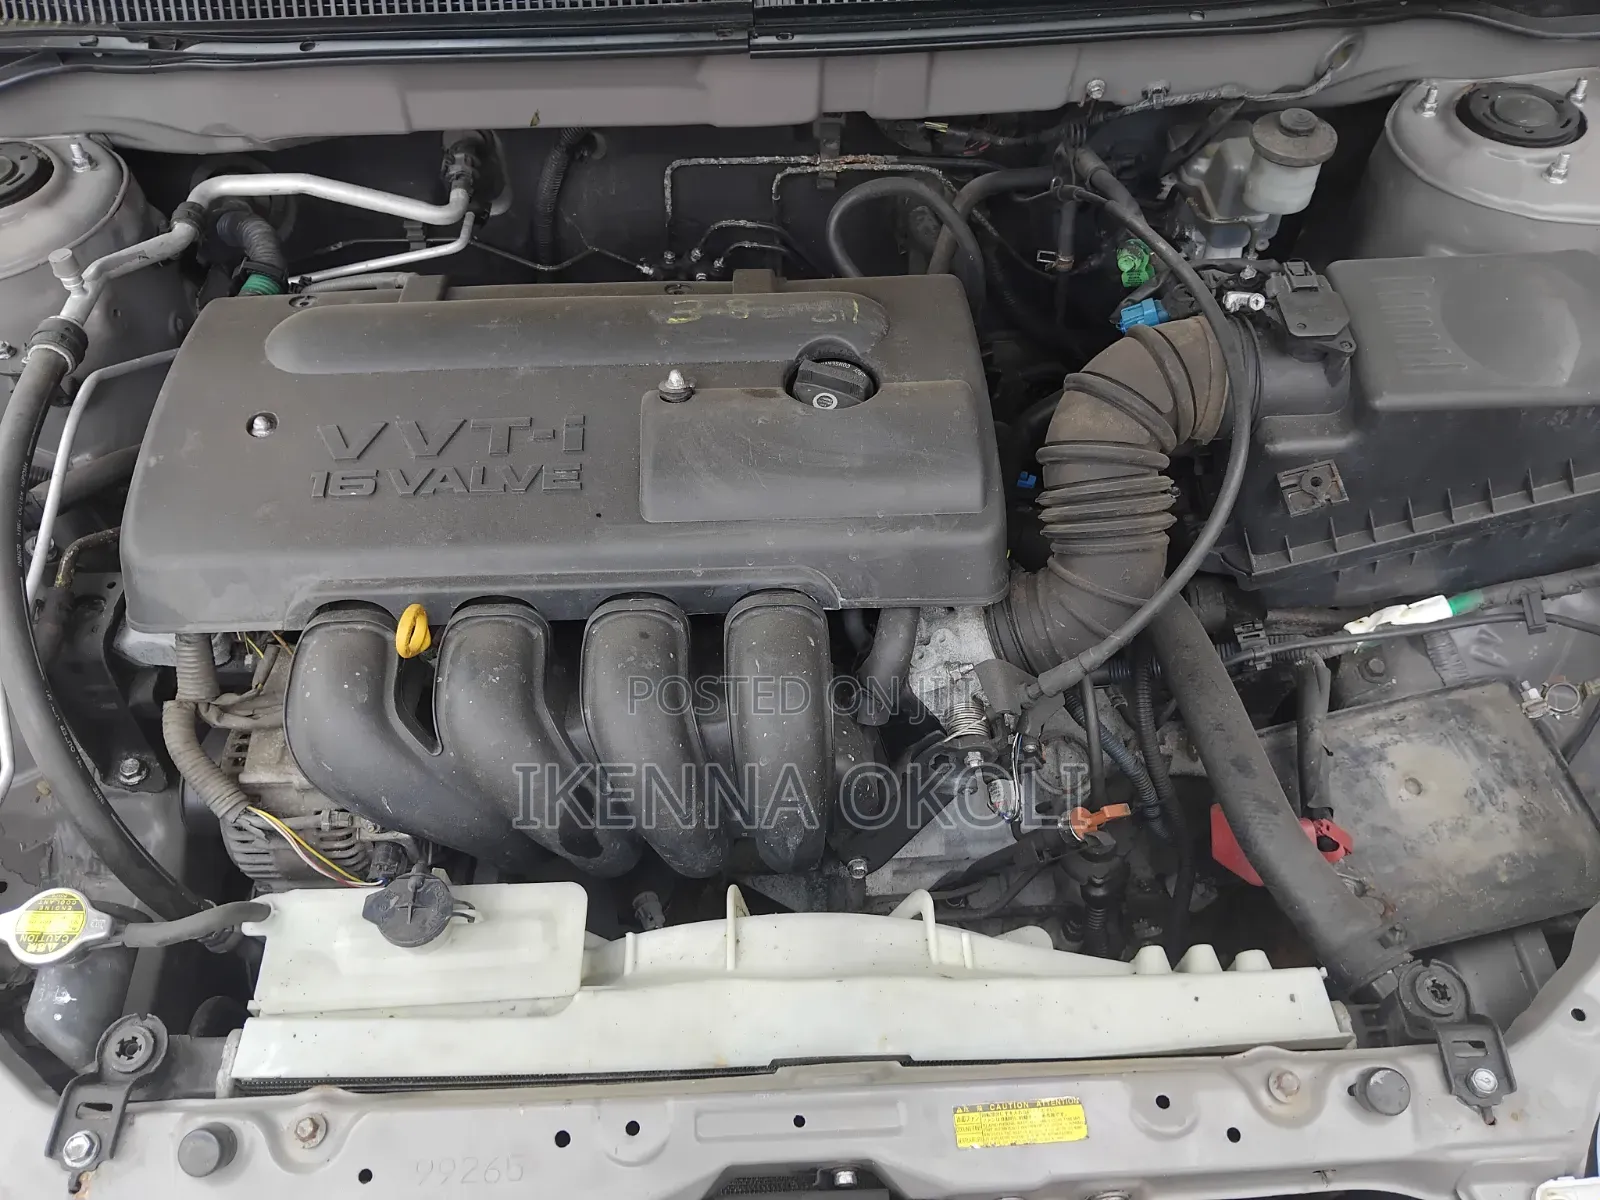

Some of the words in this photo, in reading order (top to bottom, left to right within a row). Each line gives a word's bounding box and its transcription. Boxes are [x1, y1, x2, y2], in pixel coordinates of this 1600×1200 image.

[310, 468, 379, 498] 16
[385, 463, 583, 496] VALVE
[20, 934, 70, 943] CAUTION
[989, 1101, 1029, 1111] CAUTION
[1036, 1096, 1080, 1107] ATTENTION
